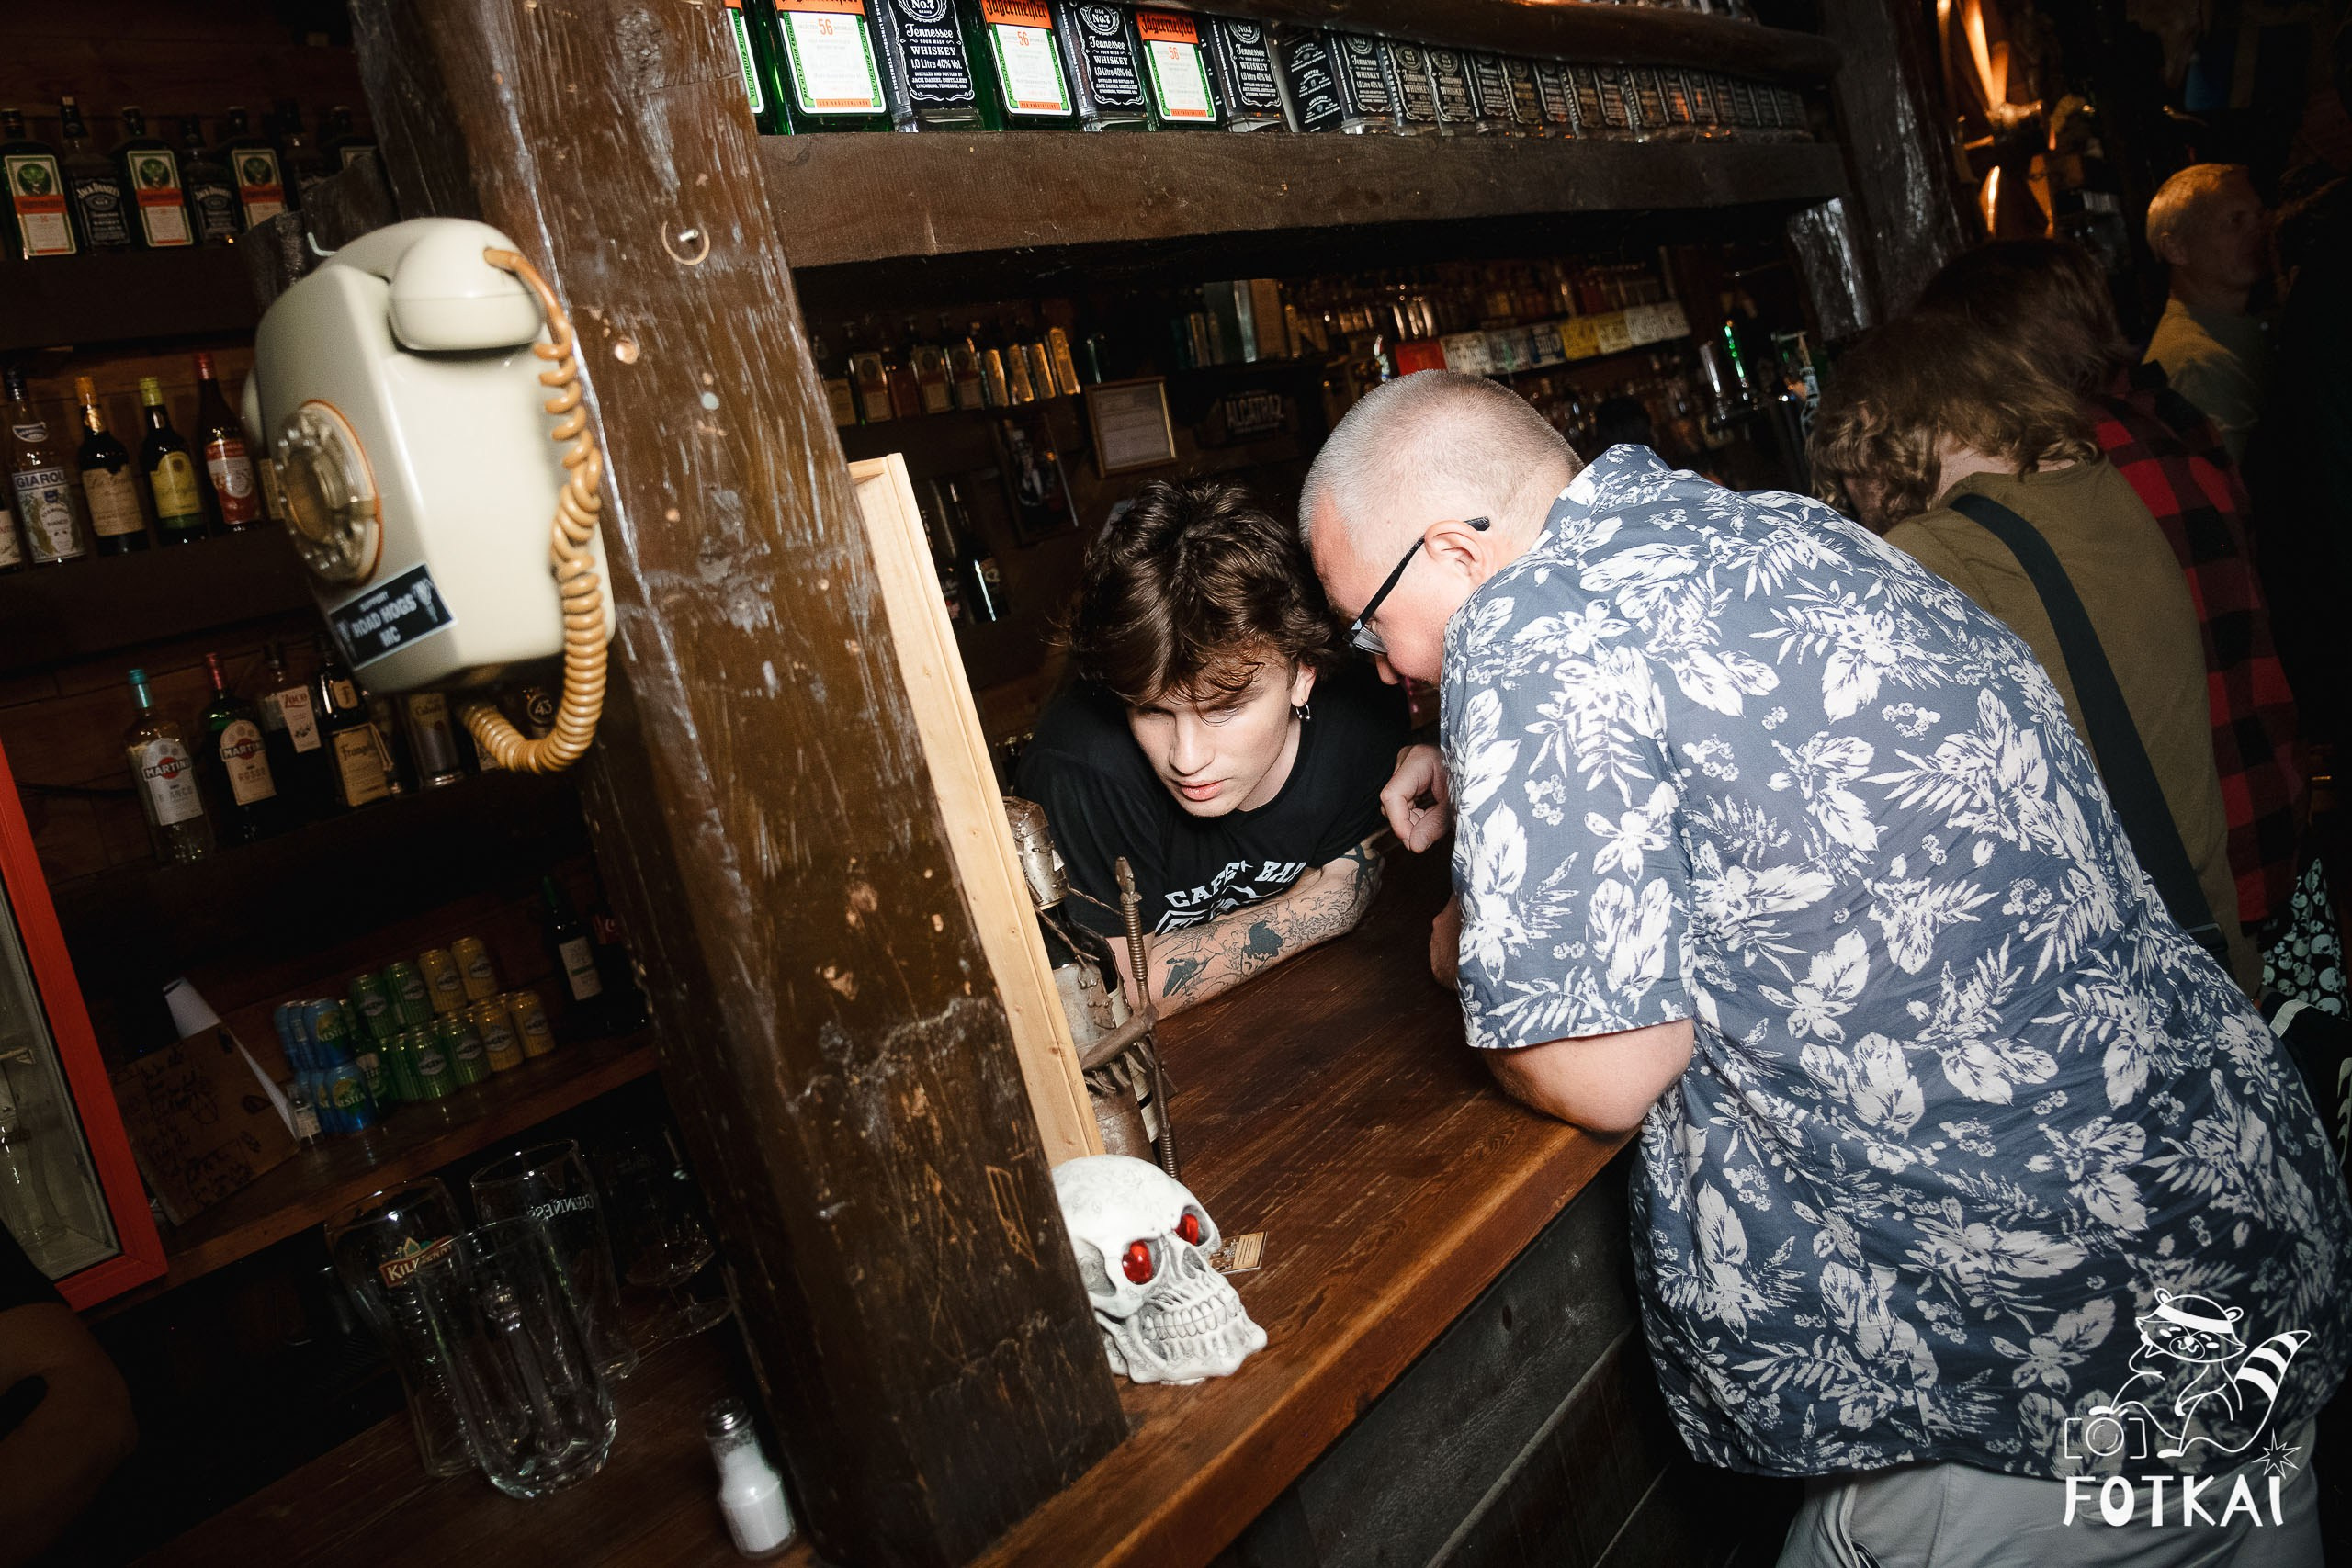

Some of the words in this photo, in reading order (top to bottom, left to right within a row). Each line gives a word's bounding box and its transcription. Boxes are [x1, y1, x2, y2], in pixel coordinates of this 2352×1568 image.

[818, 18, 833, 36] 56
[905, 23, 954, 38] Tennessee
[1017, 31, 1030, 47] 56
[1088, 35, 1126, 51] Tennessee
[910, 46, 956, 56] WHISKEY
[922, 59, 937, 69] Litre
[937, 60, 952, 69] 40%
[1093, 55, 1128, 66] WHISKEY
[1239, 61, 1268, 72] WHISKEY
[350, 612, 382, 638] ROAD
[379, 592, 417, 624] HOGS
[379, 626, 401, 647] MC
[534, 699, 552, 716] 43
